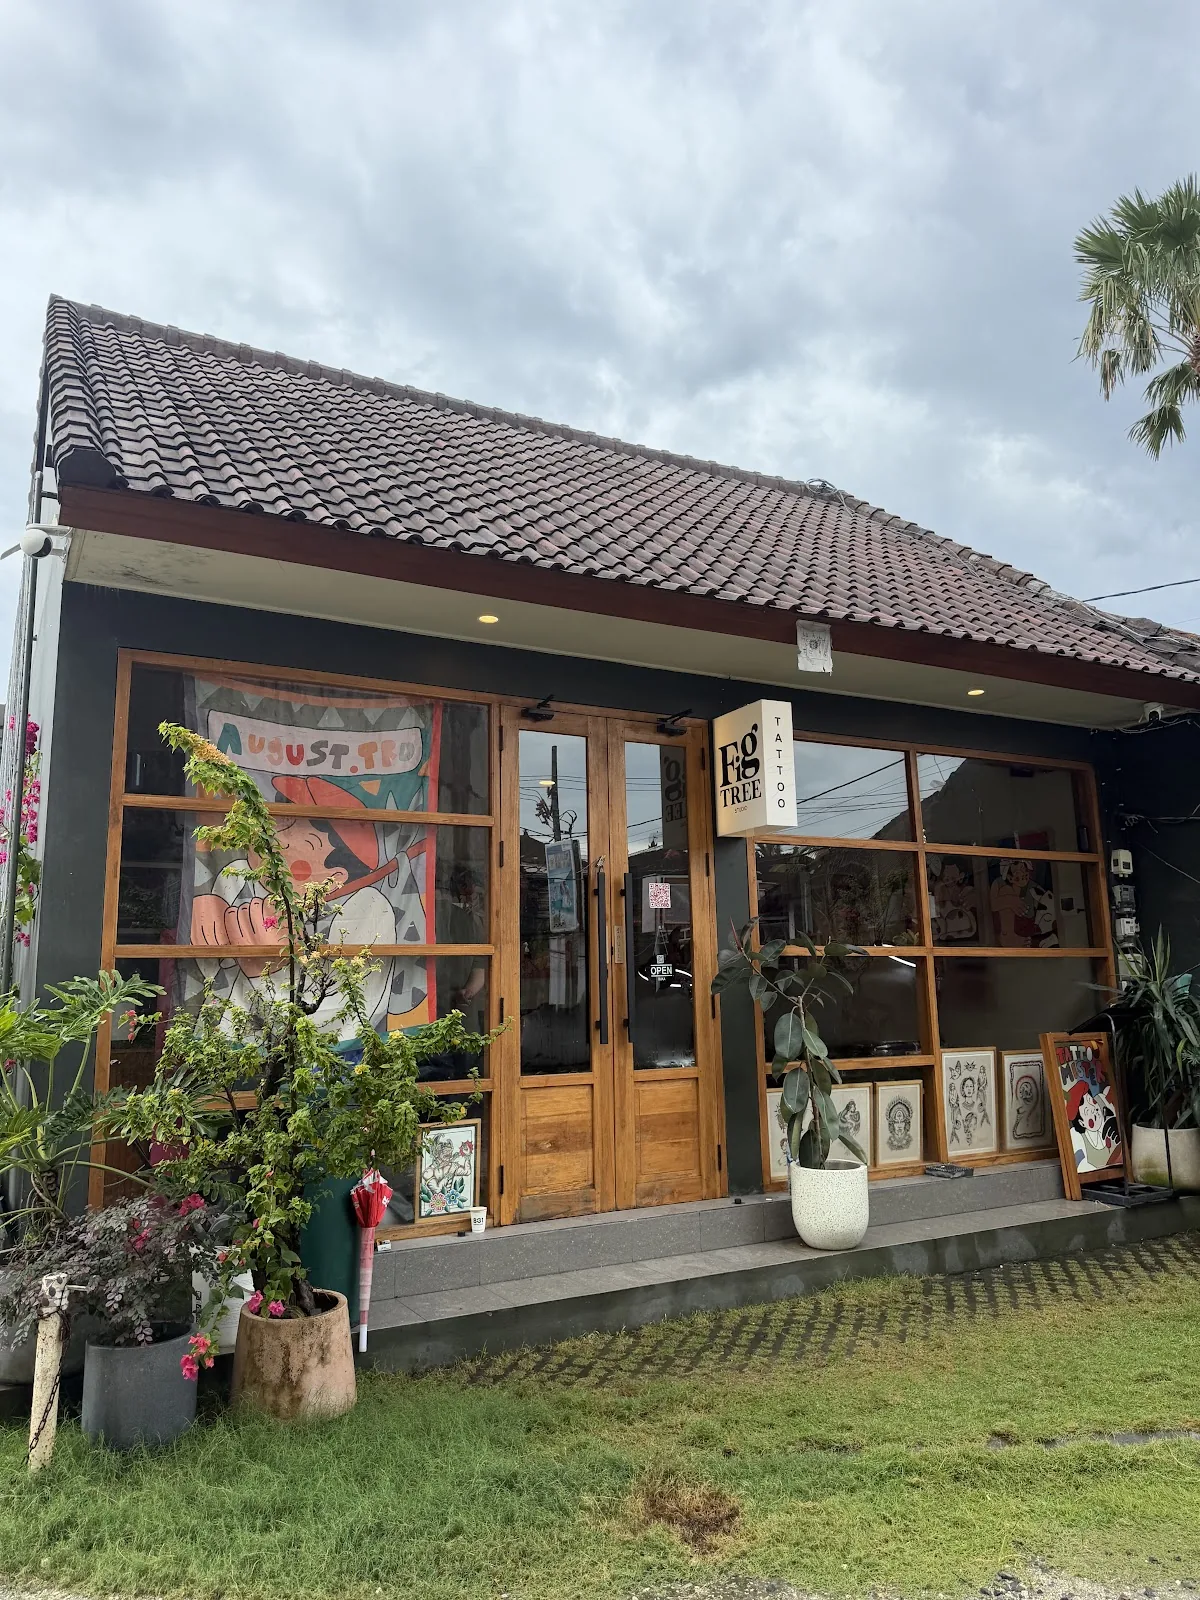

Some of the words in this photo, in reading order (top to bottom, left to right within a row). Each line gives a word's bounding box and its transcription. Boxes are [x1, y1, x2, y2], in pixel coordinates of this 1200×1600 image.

[718, 723, 760, 788] Fig
[774, 716, 786, 809] TATTOO
[719, 778, 762, 808] TREE
[650, 966, 673, 975] OPEN
